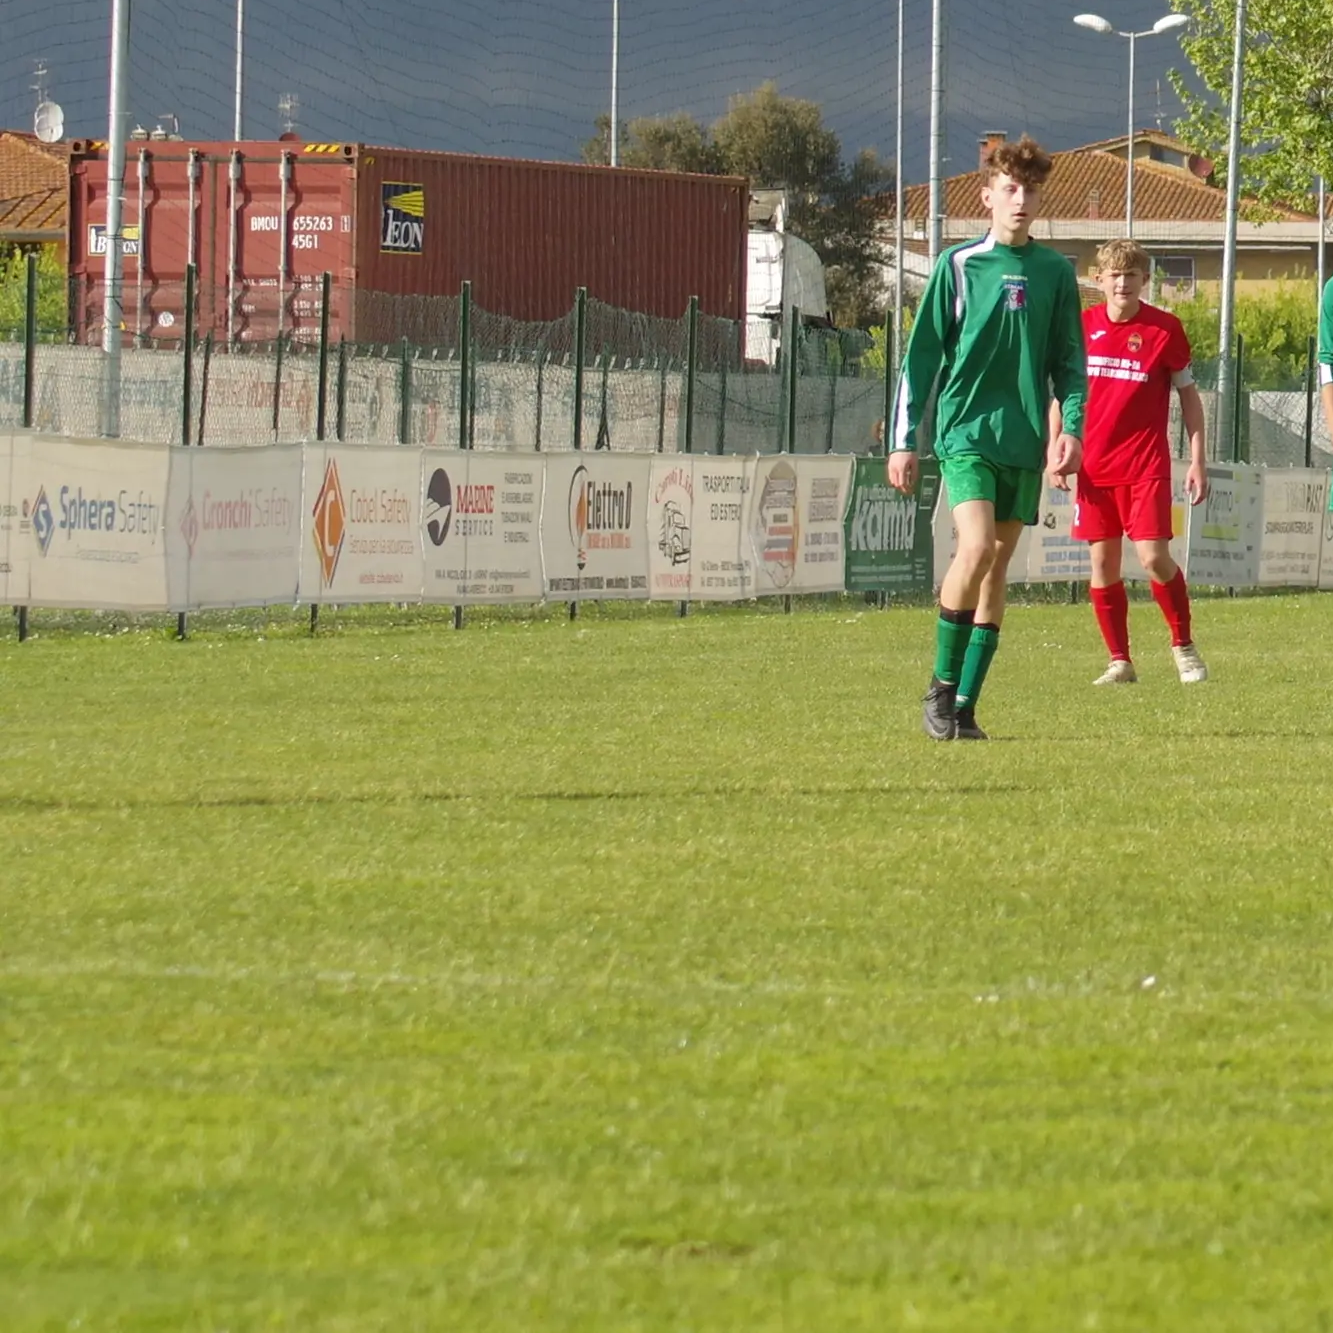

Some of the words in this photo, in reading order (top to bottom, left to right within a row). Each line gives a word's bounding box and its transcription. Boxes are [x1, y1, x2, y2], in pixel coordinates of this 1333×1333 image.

[251, 215, 278, 231] BMOU
[293, 215, 333, 231] 655263
[292, 233, 318, 249] 45G1
[202, 488, 252, 531] Gronchi
[254, 487, 294, 536] Safety
[381, 488, 411, 535] Safety
[456, 485, 495, 514] MARINE
[59, 485, 116, 540] Sphera
[118, 489, 160, 545] Safety
[455, 519, 494, 536] SERVICE
